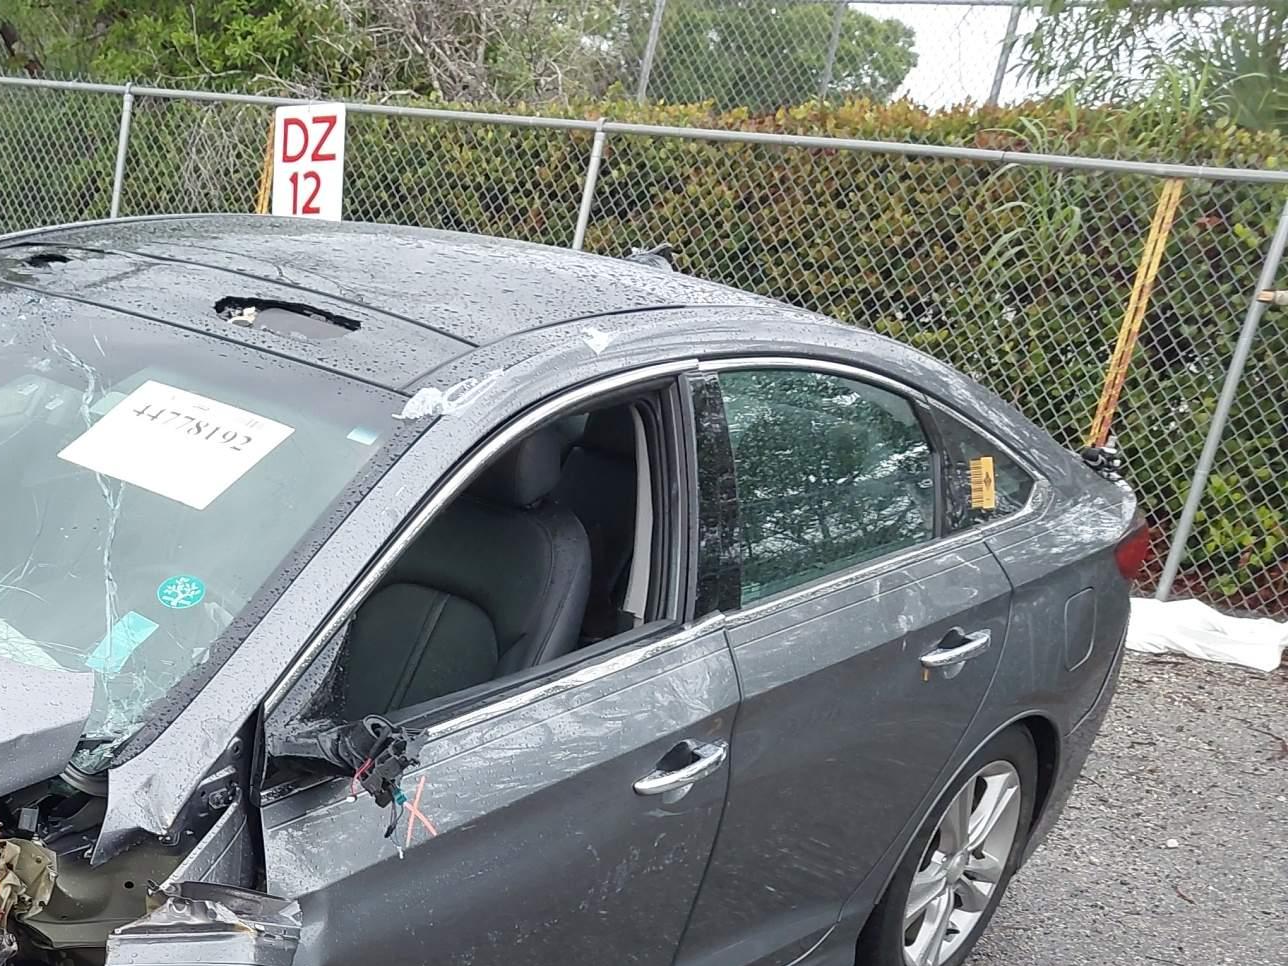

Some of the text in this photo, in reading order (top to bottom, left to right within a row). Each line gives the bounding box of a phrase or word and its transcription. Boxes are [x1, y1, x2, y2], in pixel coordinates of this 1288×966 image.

[282, 115, 337, 163] DZ
[289, 171, 321, 215] 12
[132, 404, 253, 451] 44778192
